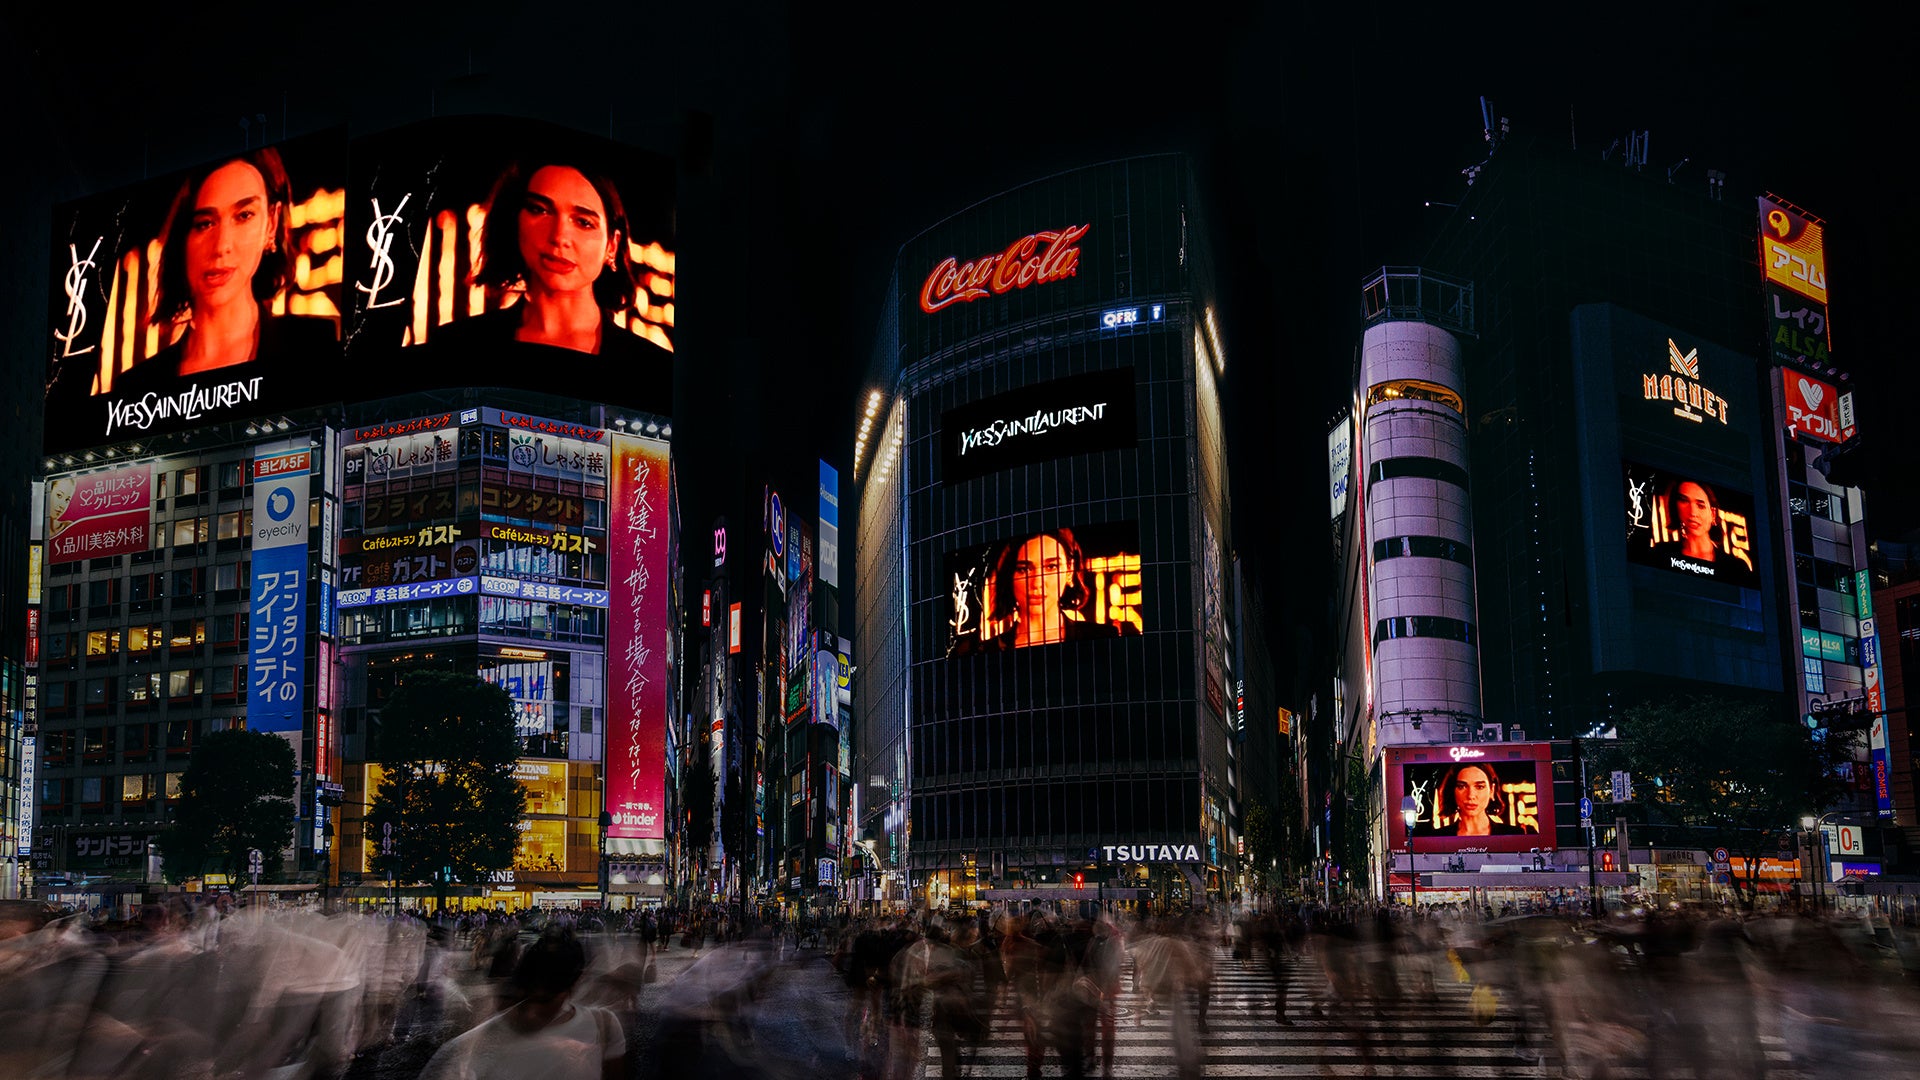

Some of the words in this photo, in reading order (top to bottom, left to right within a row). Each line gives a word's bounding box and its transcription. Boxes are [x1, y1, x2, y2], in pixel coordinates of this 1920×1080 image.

[919, 222, 1091, 314] Coca-Cola
[1772, 244, 1826, 290] アコム
[1773, 293, 1825, 335] レイク
[1775, 325, 1831, 365] ALSA
[1643, 373, 1728, 425] MAGNET
[355, 413, 452, 441] しゃぶしゃぶバイキング
[501, 411, 605, 441] しゃぶしゃぶバイキング
[1788, 404, 1838, 438] アイフル
[258, 454, 305, 475] 当ビル5F
[346, 459, 363, 474] 9F
[397, 439, 453, 467] しゃぶ葉
[543, 445, 604, 474] しゃぶ葉
[93, 473, 147, 495] 品川スキン
[93, 490, 140, 511] クリニック
[366, 493, 453, 522] プライス
[482, 487, 581, 519] コンタクト
[62, 525, 145, 553] 品川美容外科
[258, 522, 302, 541] eyecity
[417, 524, 461, 547] ガスト
[551, 532, 597, 555] ガスト
[342, 566, 362, 583] 7F
[392, 554, 446, 583] ガスト
[341, 591, 367, 604] AEON
[374, 582, 454, 603] 英会話イーオン
[486, 580, 514, 593] AEON
[522, 583, 607, 604] 英会話イーオン
[254, 572, 280, 703] アイシティ
[279, 569, 300, 701] コンタクトの
[1236, 679, 1245, 731] SEIBU
[1450, 747, 1485, 761] Glico
[1877, 760, 1888, 799] PROMISE
[623, 812, 657, 826] tinder
[1103, 844, 1199, 861] TSUTAYA
